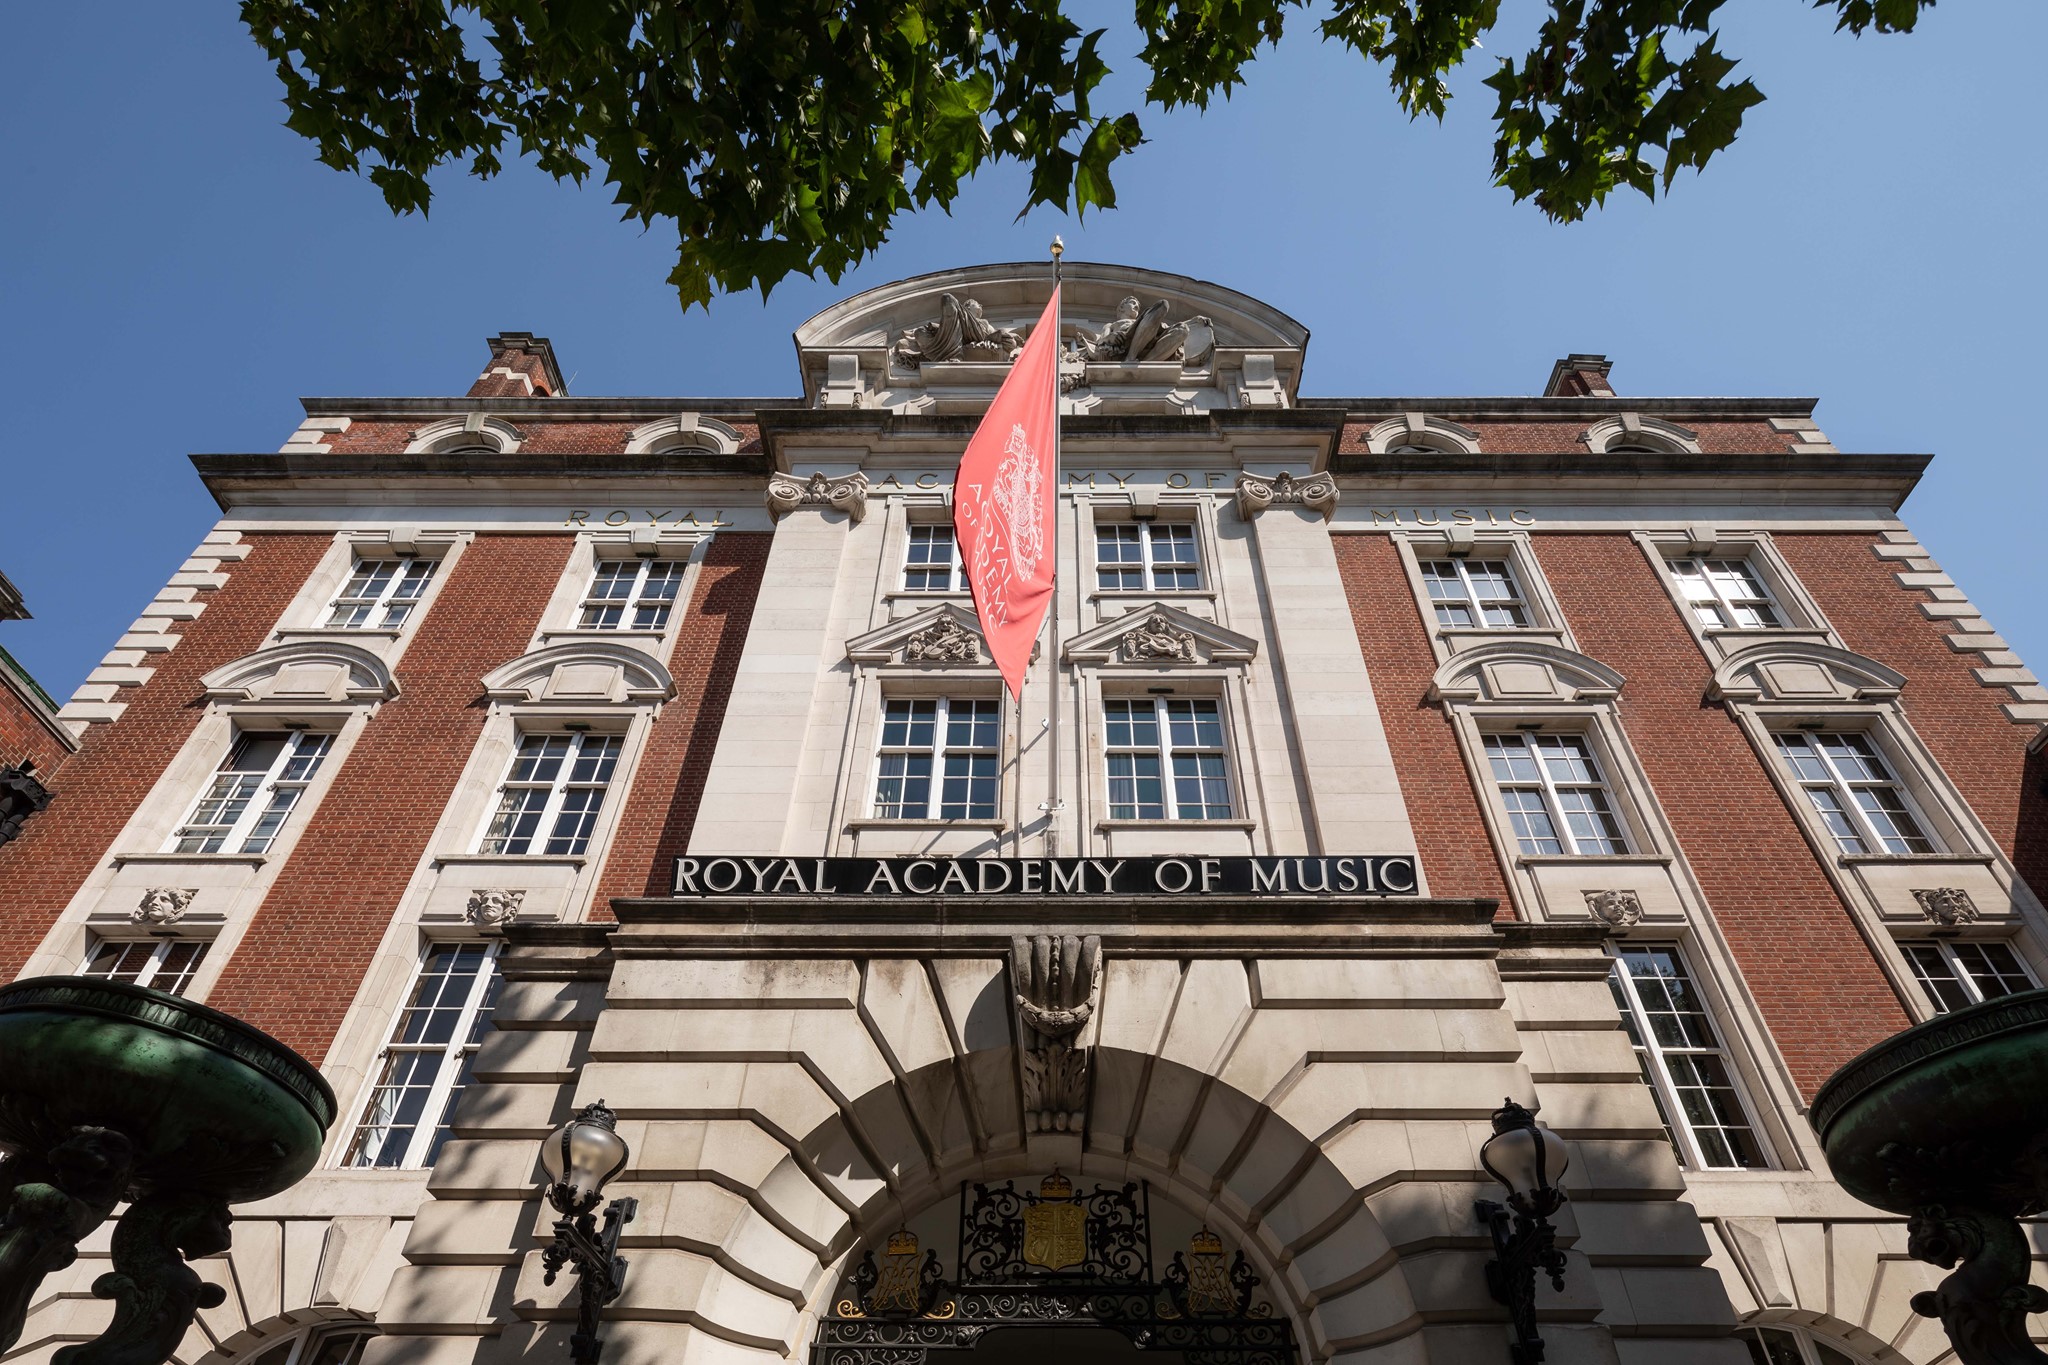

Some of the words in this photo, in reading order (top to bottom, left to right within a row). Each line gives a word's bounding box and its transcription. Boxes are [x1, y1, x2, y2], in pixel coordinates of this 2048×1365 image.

[564, 509, 735, 527] ROYAL
[876, 471, 1135, 490] ACMY
[1165, 471, 1228, 490] OF
[1370, 508, 1536, 527] MUSIC
[962, 502, 979, 528] OF
[984, 509, 1012, 595] OYAL
[675, 858, 837, 893] ROYAL
[863, 859, 1126, 894] ACADEMY
[1154, 858, 1222, 893] OF
[1249, 857, 1414, 893] MUSIC
